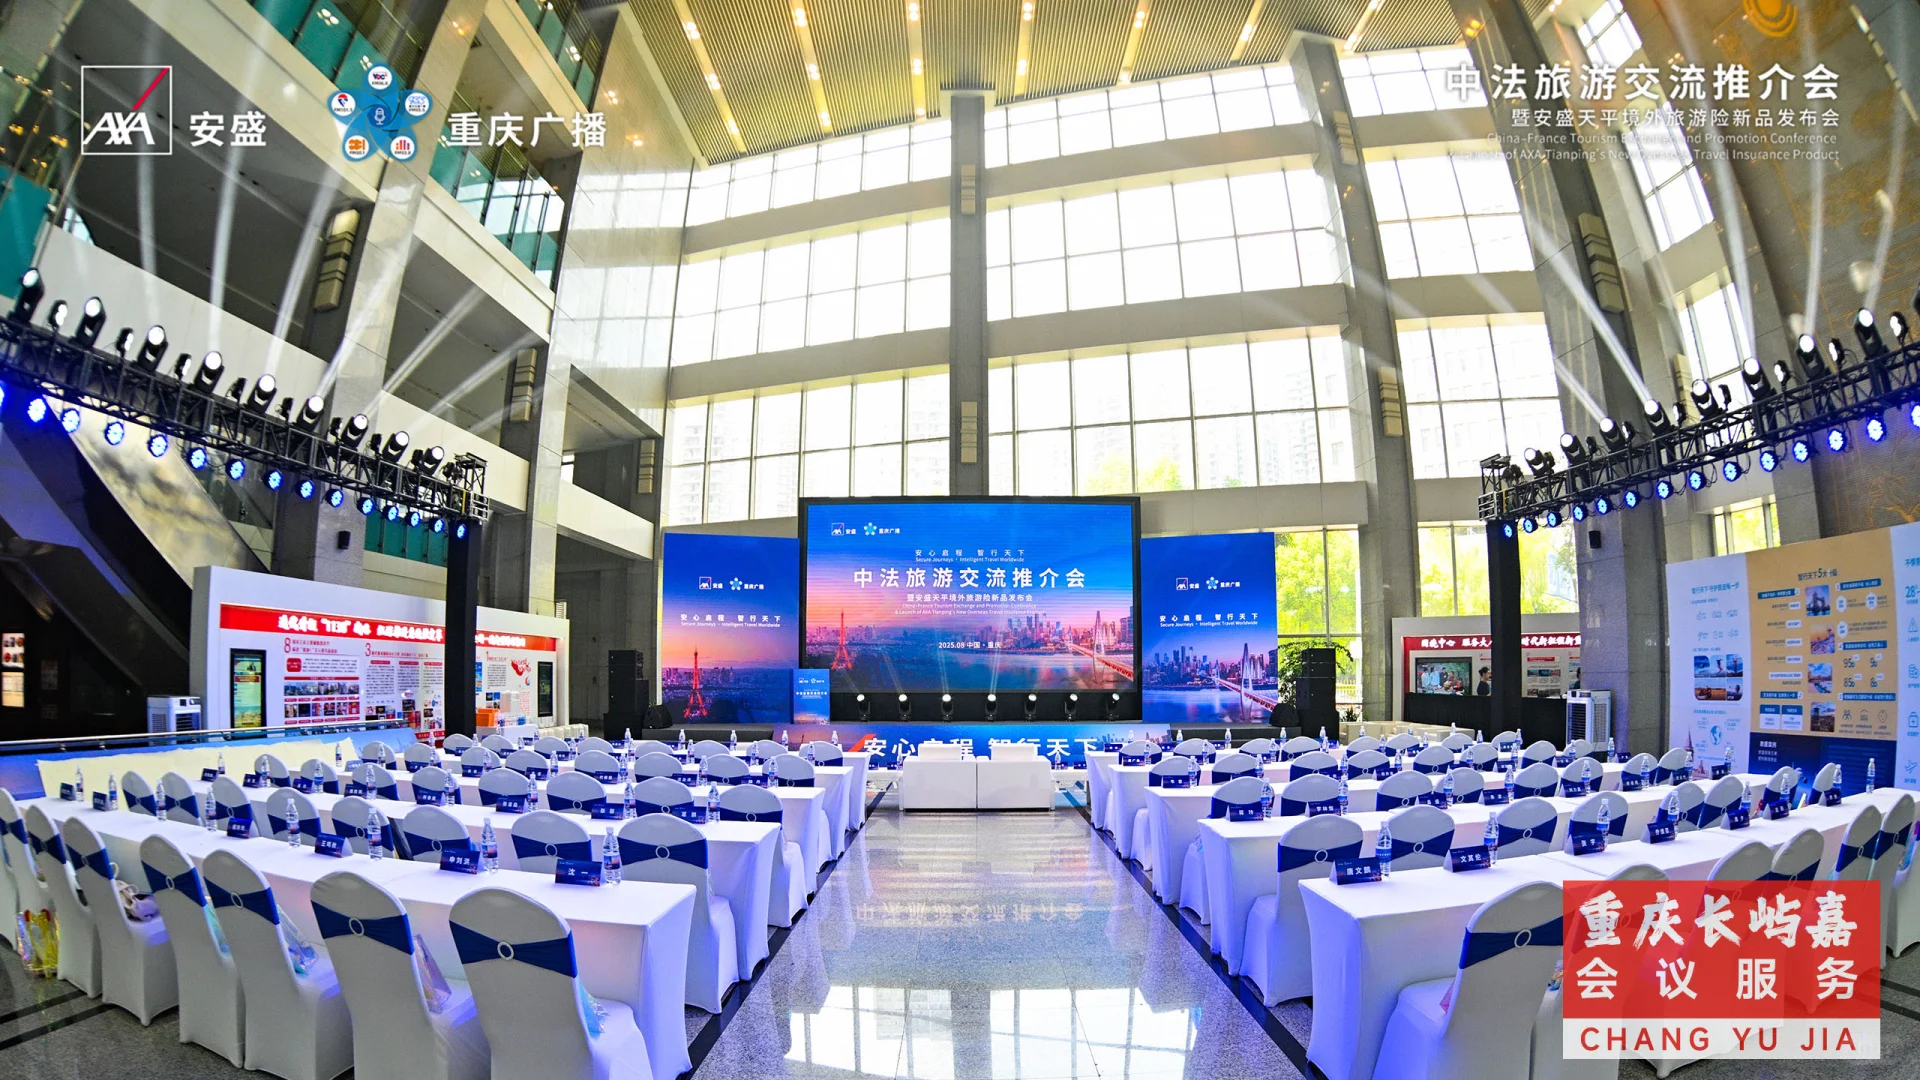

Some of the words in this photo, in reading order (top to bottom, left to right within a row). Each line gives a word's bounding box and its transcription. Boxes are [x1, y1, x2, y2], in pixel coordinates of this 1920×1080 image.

[853, 567, 1085, 589] 中法旅游交流推介会
[907, 593, 1033, 602] 暨安盛天平境外旅游险新品发布会
[938, 641, 965, 649] 2025.08
[1462, 637, 1492, 647] 服务大
[863, 737, 974, 759] 安心程
